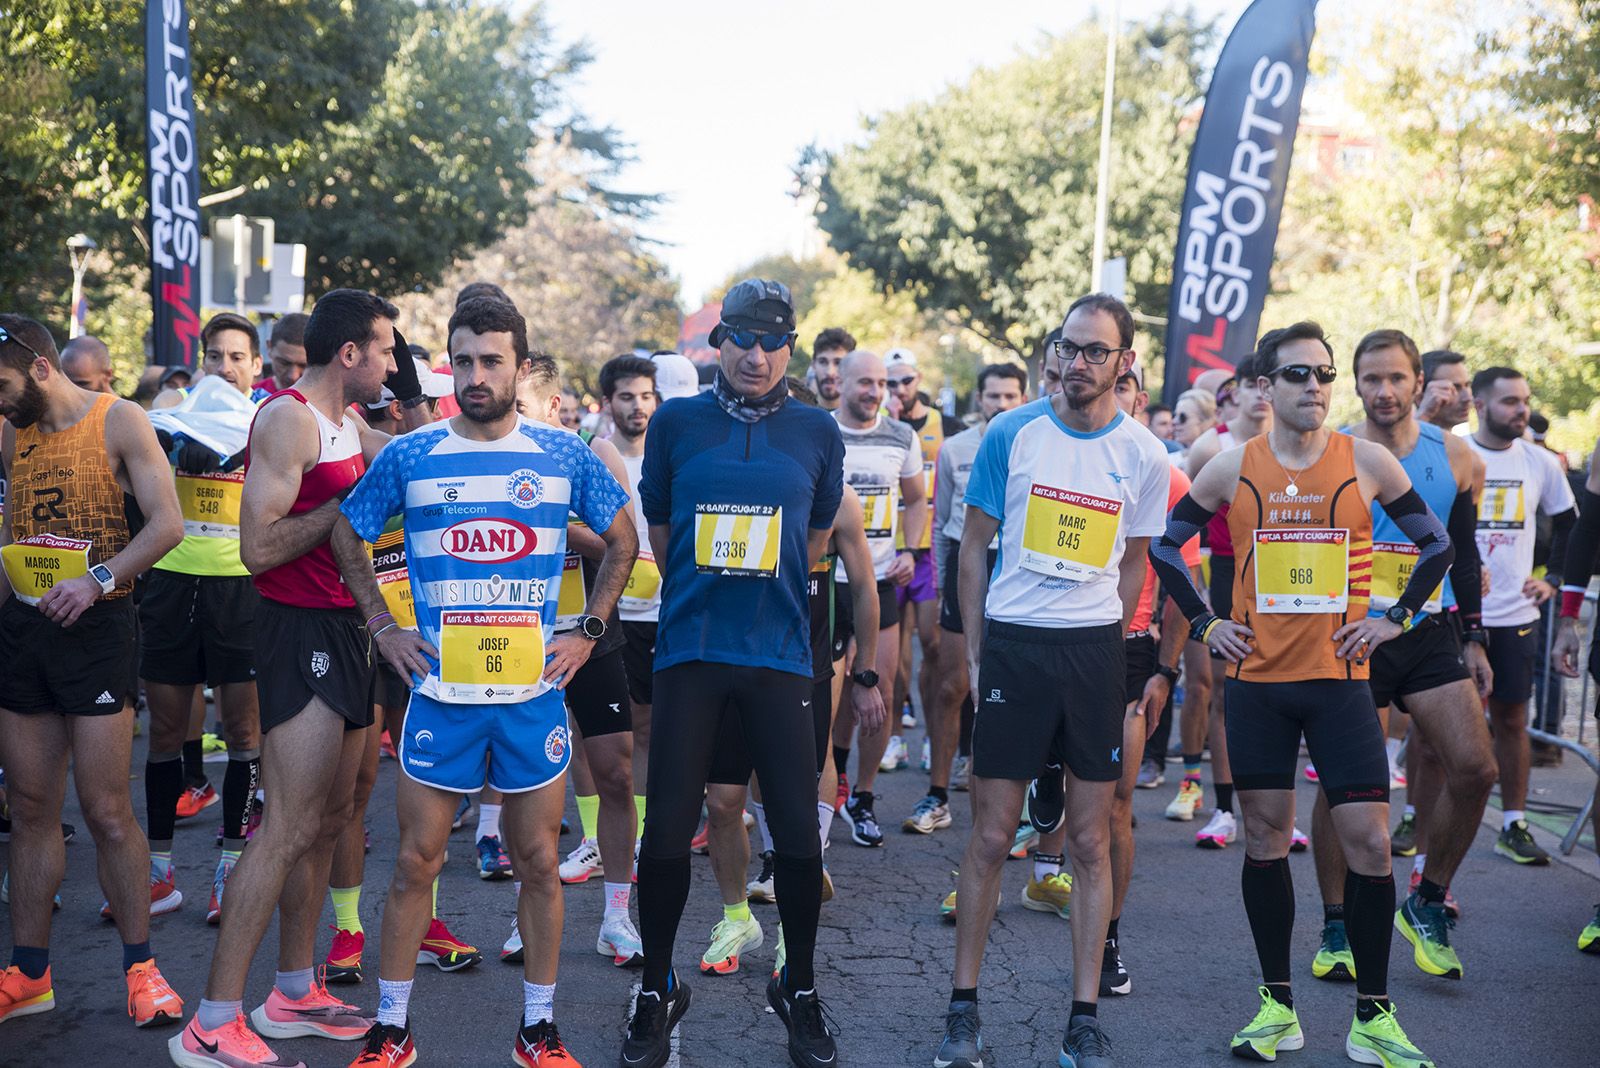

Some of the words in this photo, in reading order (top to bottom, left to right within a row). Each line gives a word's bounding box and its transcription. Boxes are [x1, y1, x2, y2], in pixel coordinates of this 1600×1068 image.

[161, 0, 200, 267] SPORTS
[1204, 55, 1293, 322] SPORTS
[1178, 170, 1226, 324] RPM
[196, 487, 224, 499] SERGIO
[1033, 487, 1057, 499] MITJA
[1059, 492, 1081, 503] SANT
[1080, 496, 1109, 509] CUGAT
[1108, 503, 1119, 511] 22
[1268, 491, 1326, 504] Kilometer
[199, 500, 219, 514] 548
[706, 504, 730, 513] SANT
[730, 504, 762, 514] CUGAT
[762, 506, 774, 514] 22
[1058, 513, 1087, 531] MARC
[45, 538, 74, 548] CUGAT
[451, 529, 517, 553] DANI
[1057, 530, 1081, 550] 845
[1258, 533, 1281, 541] MITJA
[1282, 532, 1304, 540] SANT
[1304, 533, 1334, 541] CUGAT
[715, 540, 747, 559] 2336
[25, 556, 60, 570] MARCOS
[33, 571, 54, 588] 799
[1290, 568, 1313, 585] 968
[509, 579, 545, 603] MÉS
[447, 616, 472, 624] MITJA
[474, 615, 497, 624] SANT
[498, 615, 527, 623] CUGAT
[527, 615, 537, 624] 22
[478, 637, 510, 651] JOSEP
[486, 655, 503, 673] 66
